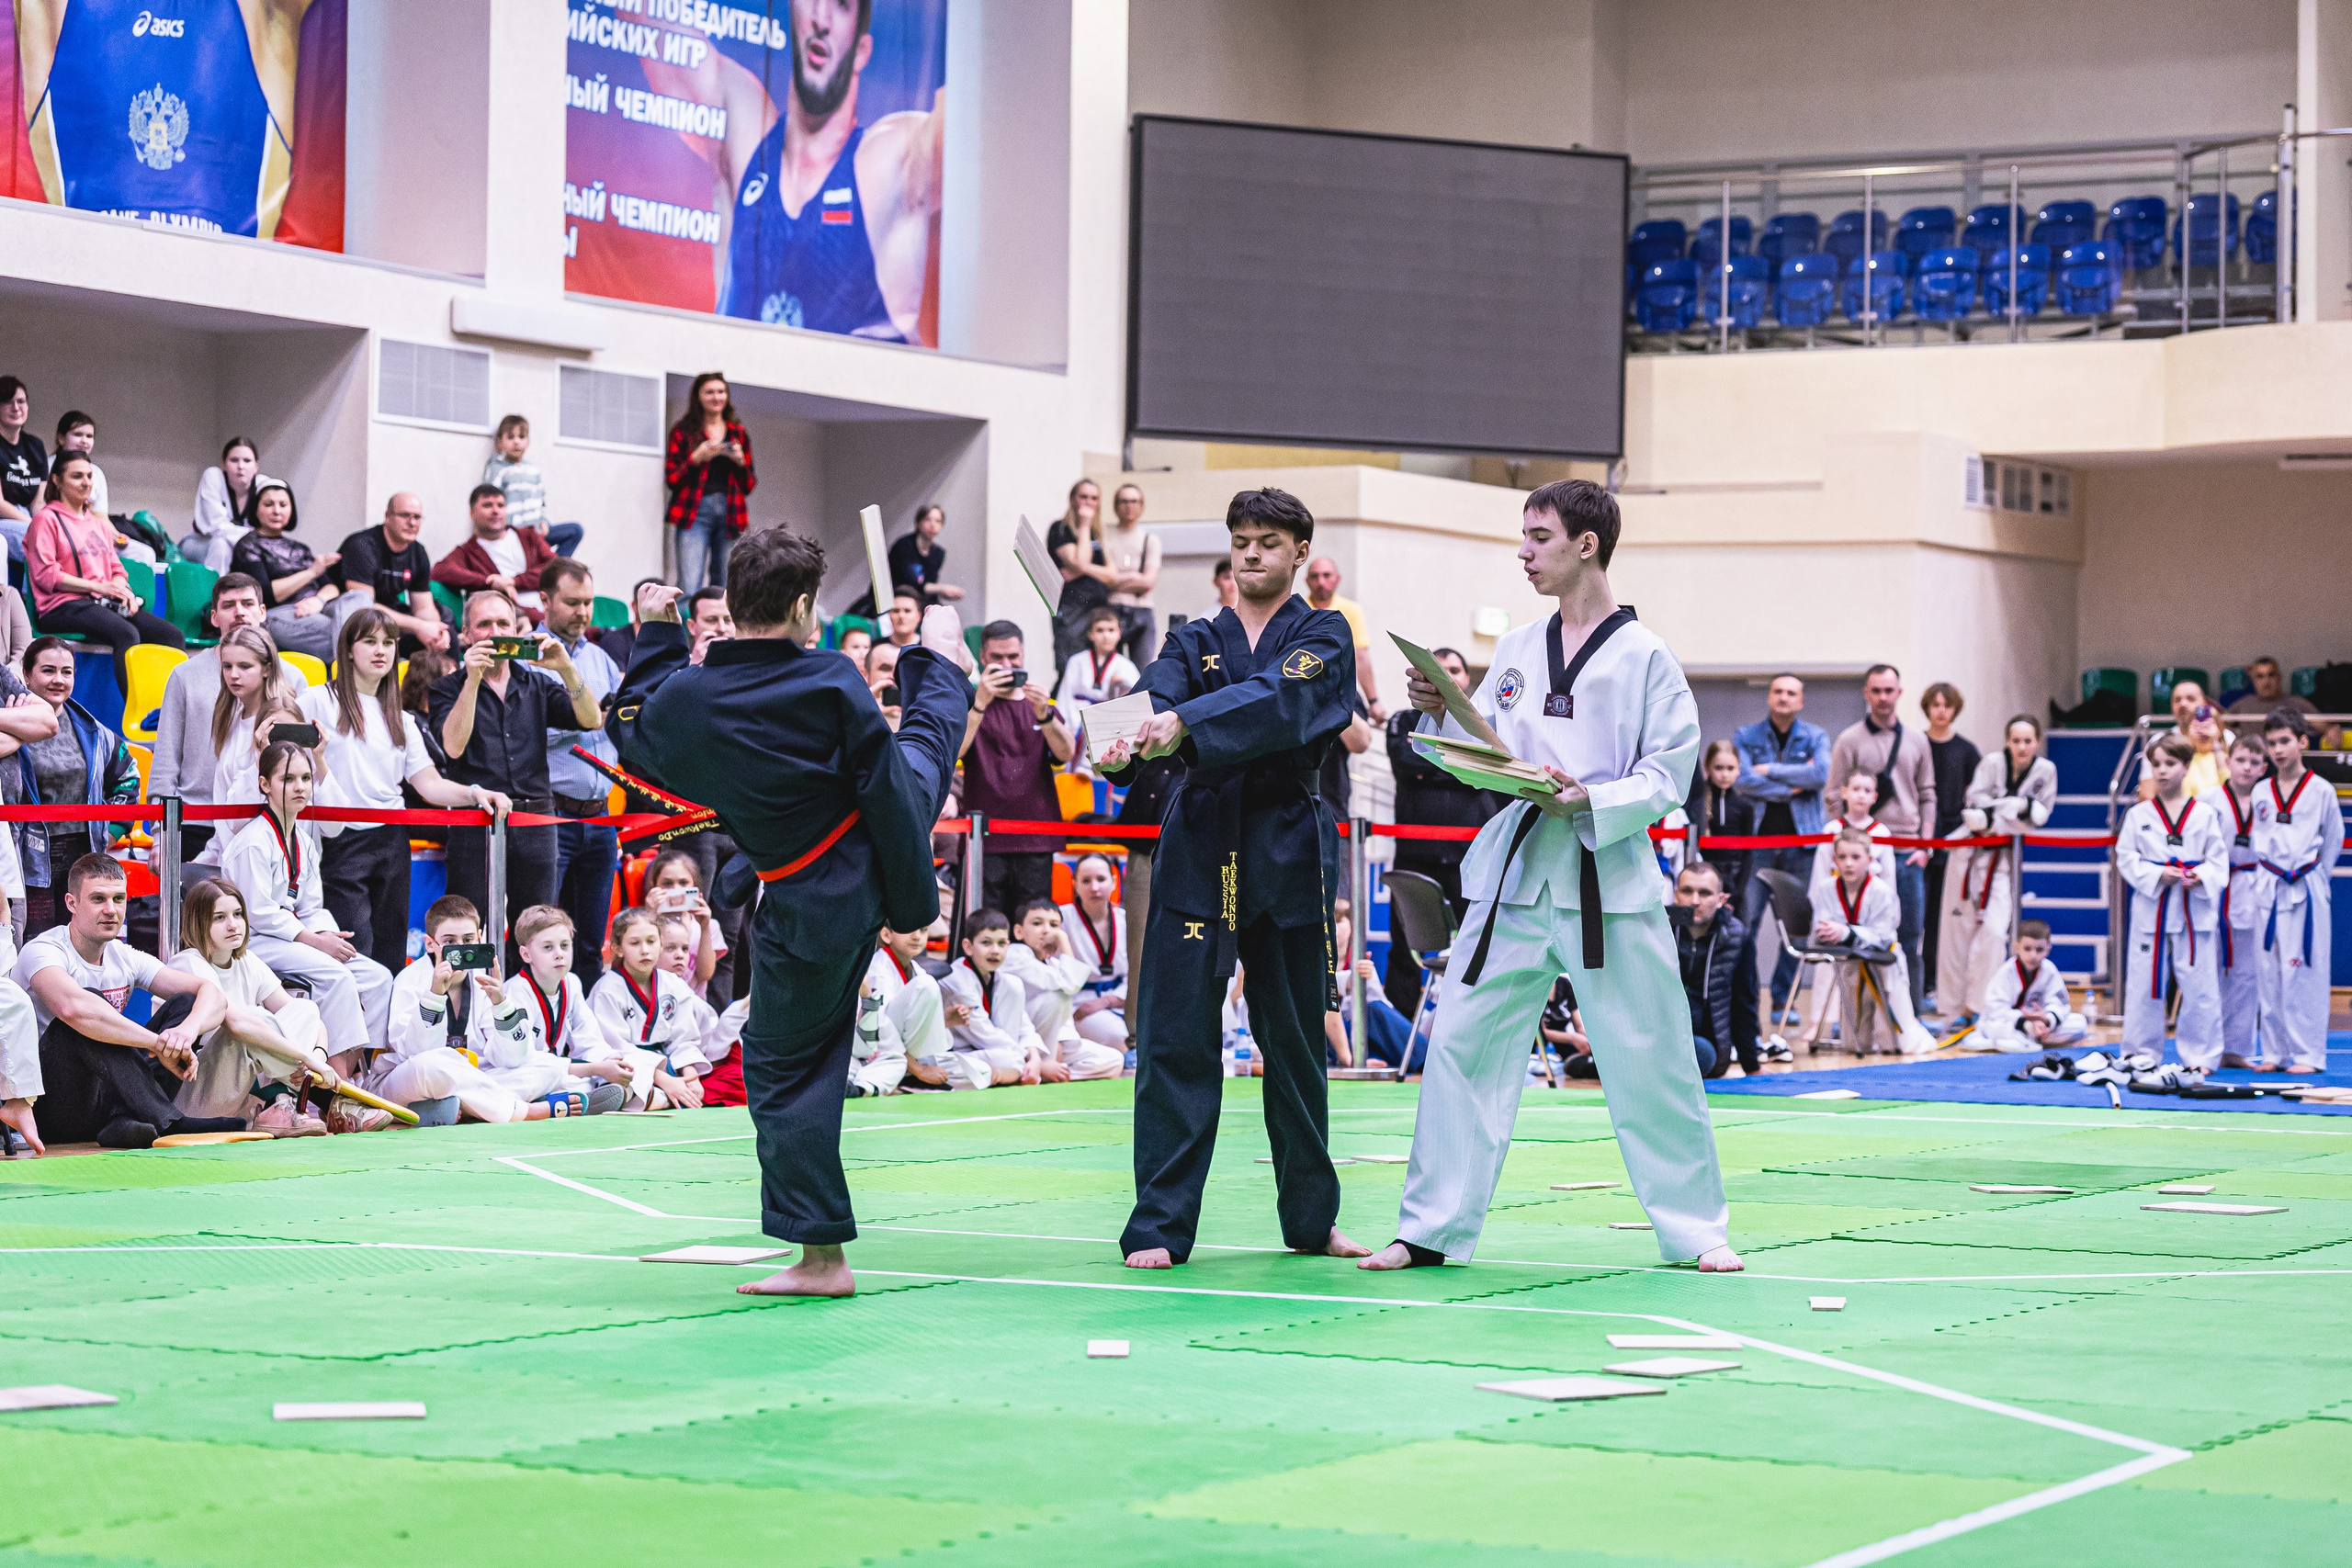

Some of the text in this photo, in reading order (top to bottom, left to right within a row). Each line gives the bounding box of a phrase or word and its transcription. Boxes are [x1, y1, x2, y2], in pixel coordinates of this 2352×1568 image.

[662, 32, 708, 70] ИГР
[614, 85, 728, 141] ЧЕМПИОН
[610, 192, 721, 245] ЧЕМПИОН
[1220, 865, 1230, 919] RUSSIA
[1228, 852, 1238, 931] TAEKWONDO
